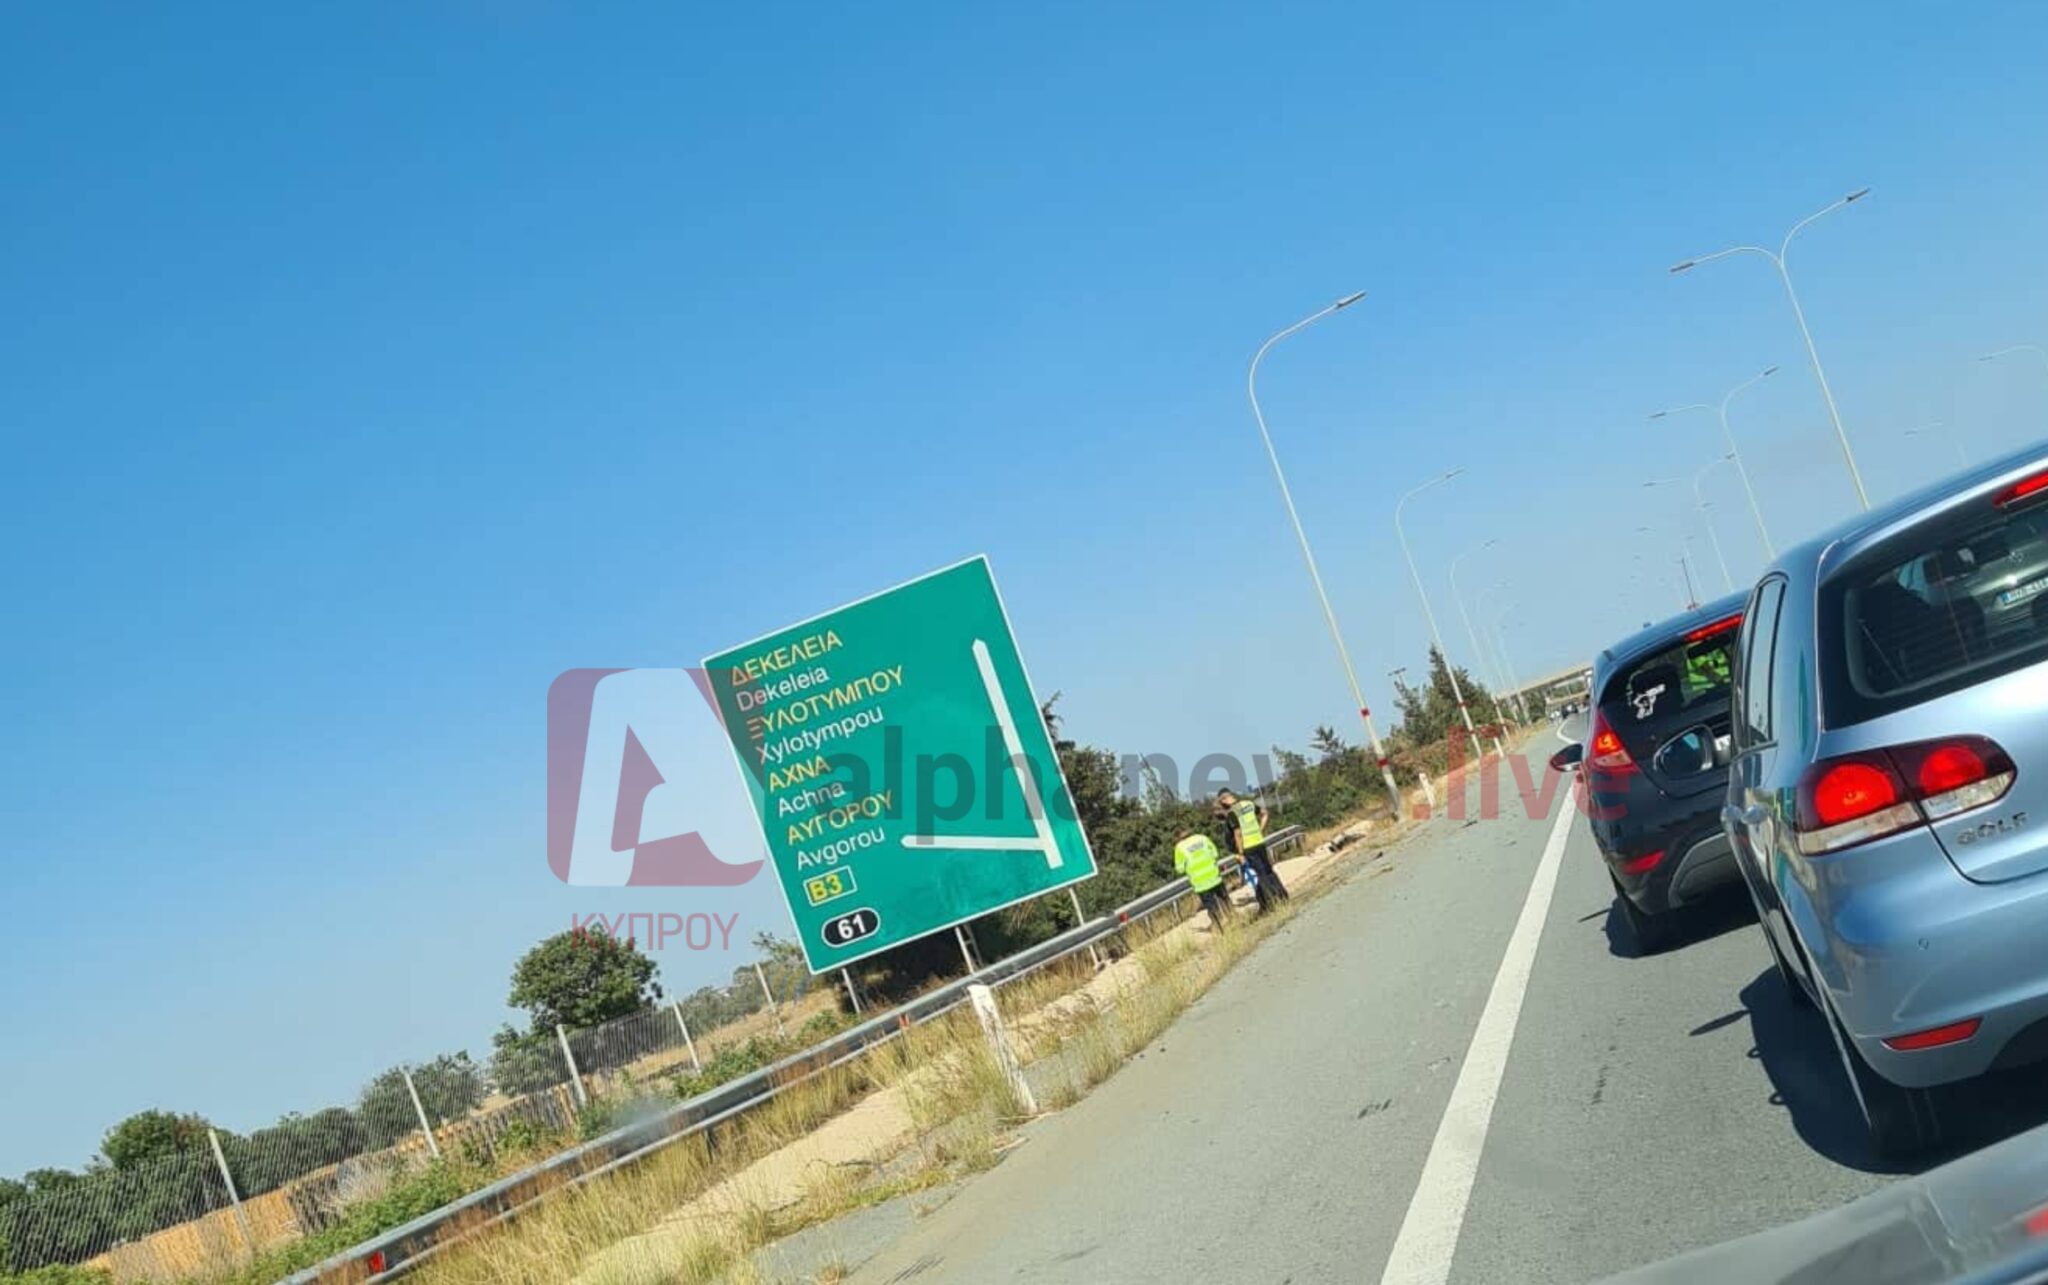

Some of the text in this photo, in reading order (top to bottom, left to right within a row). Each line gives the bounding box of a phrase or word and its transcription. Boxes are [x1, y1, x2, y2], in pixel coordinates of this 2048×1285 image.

[731, 630, 842, 687] ΔΕΚΕΛΕΙΑ
[737, 666, 829, 712] Dekeleia
[748, 665, 904, 739] ΞΥΛΟΤΥΜΠΟΥ
[757, 705, 884, 766] Xylotympou
[768, 755, 832, 793] ΑΧΝΑ
[778, 781, 845, 818] Achna
[787, 790, 894, 845] ΑΥΓΟΡΟΥ
[796, 826, 885, 872] Avgorou
[1957, 811, 2028, 846] GOLF
[808, 872, 843, 903] B3
[837, 914, 868, 941] 61
